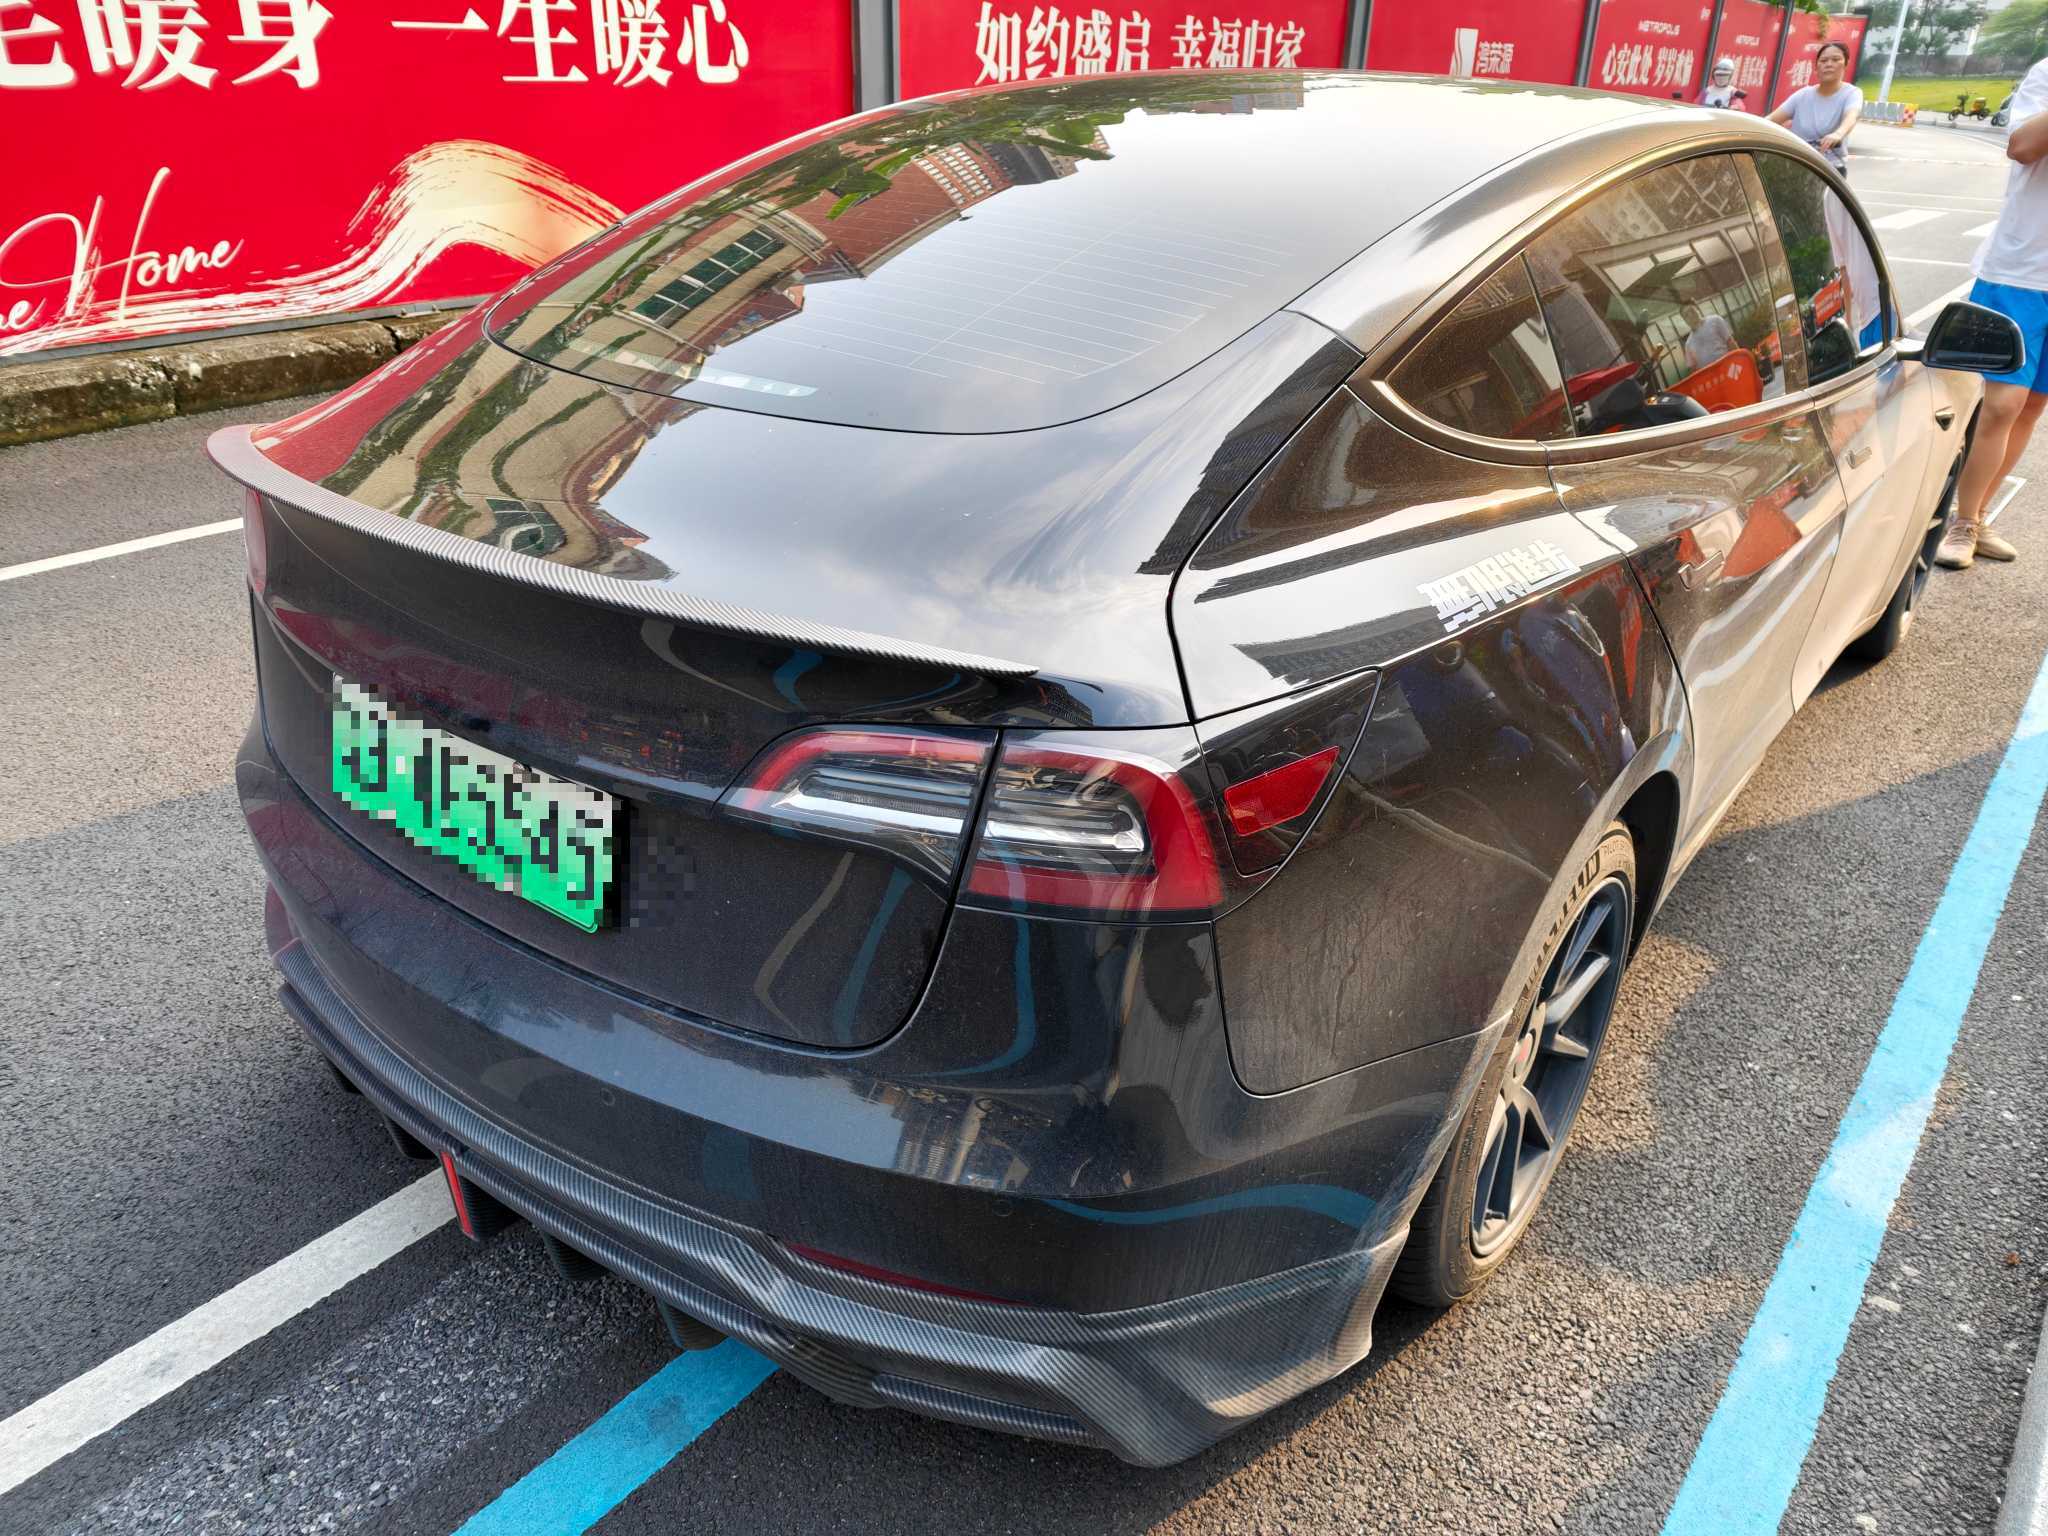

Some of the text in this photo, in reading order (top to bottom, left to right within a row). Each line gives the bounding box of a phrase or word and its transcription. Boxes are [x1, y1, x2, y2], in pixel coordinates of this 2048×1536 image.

[389, 0, 751, 89] 一生暖心
[974, 1, 1306, 86] 如约盛启 幸福归家
[0, 166, 244, 322] Home
